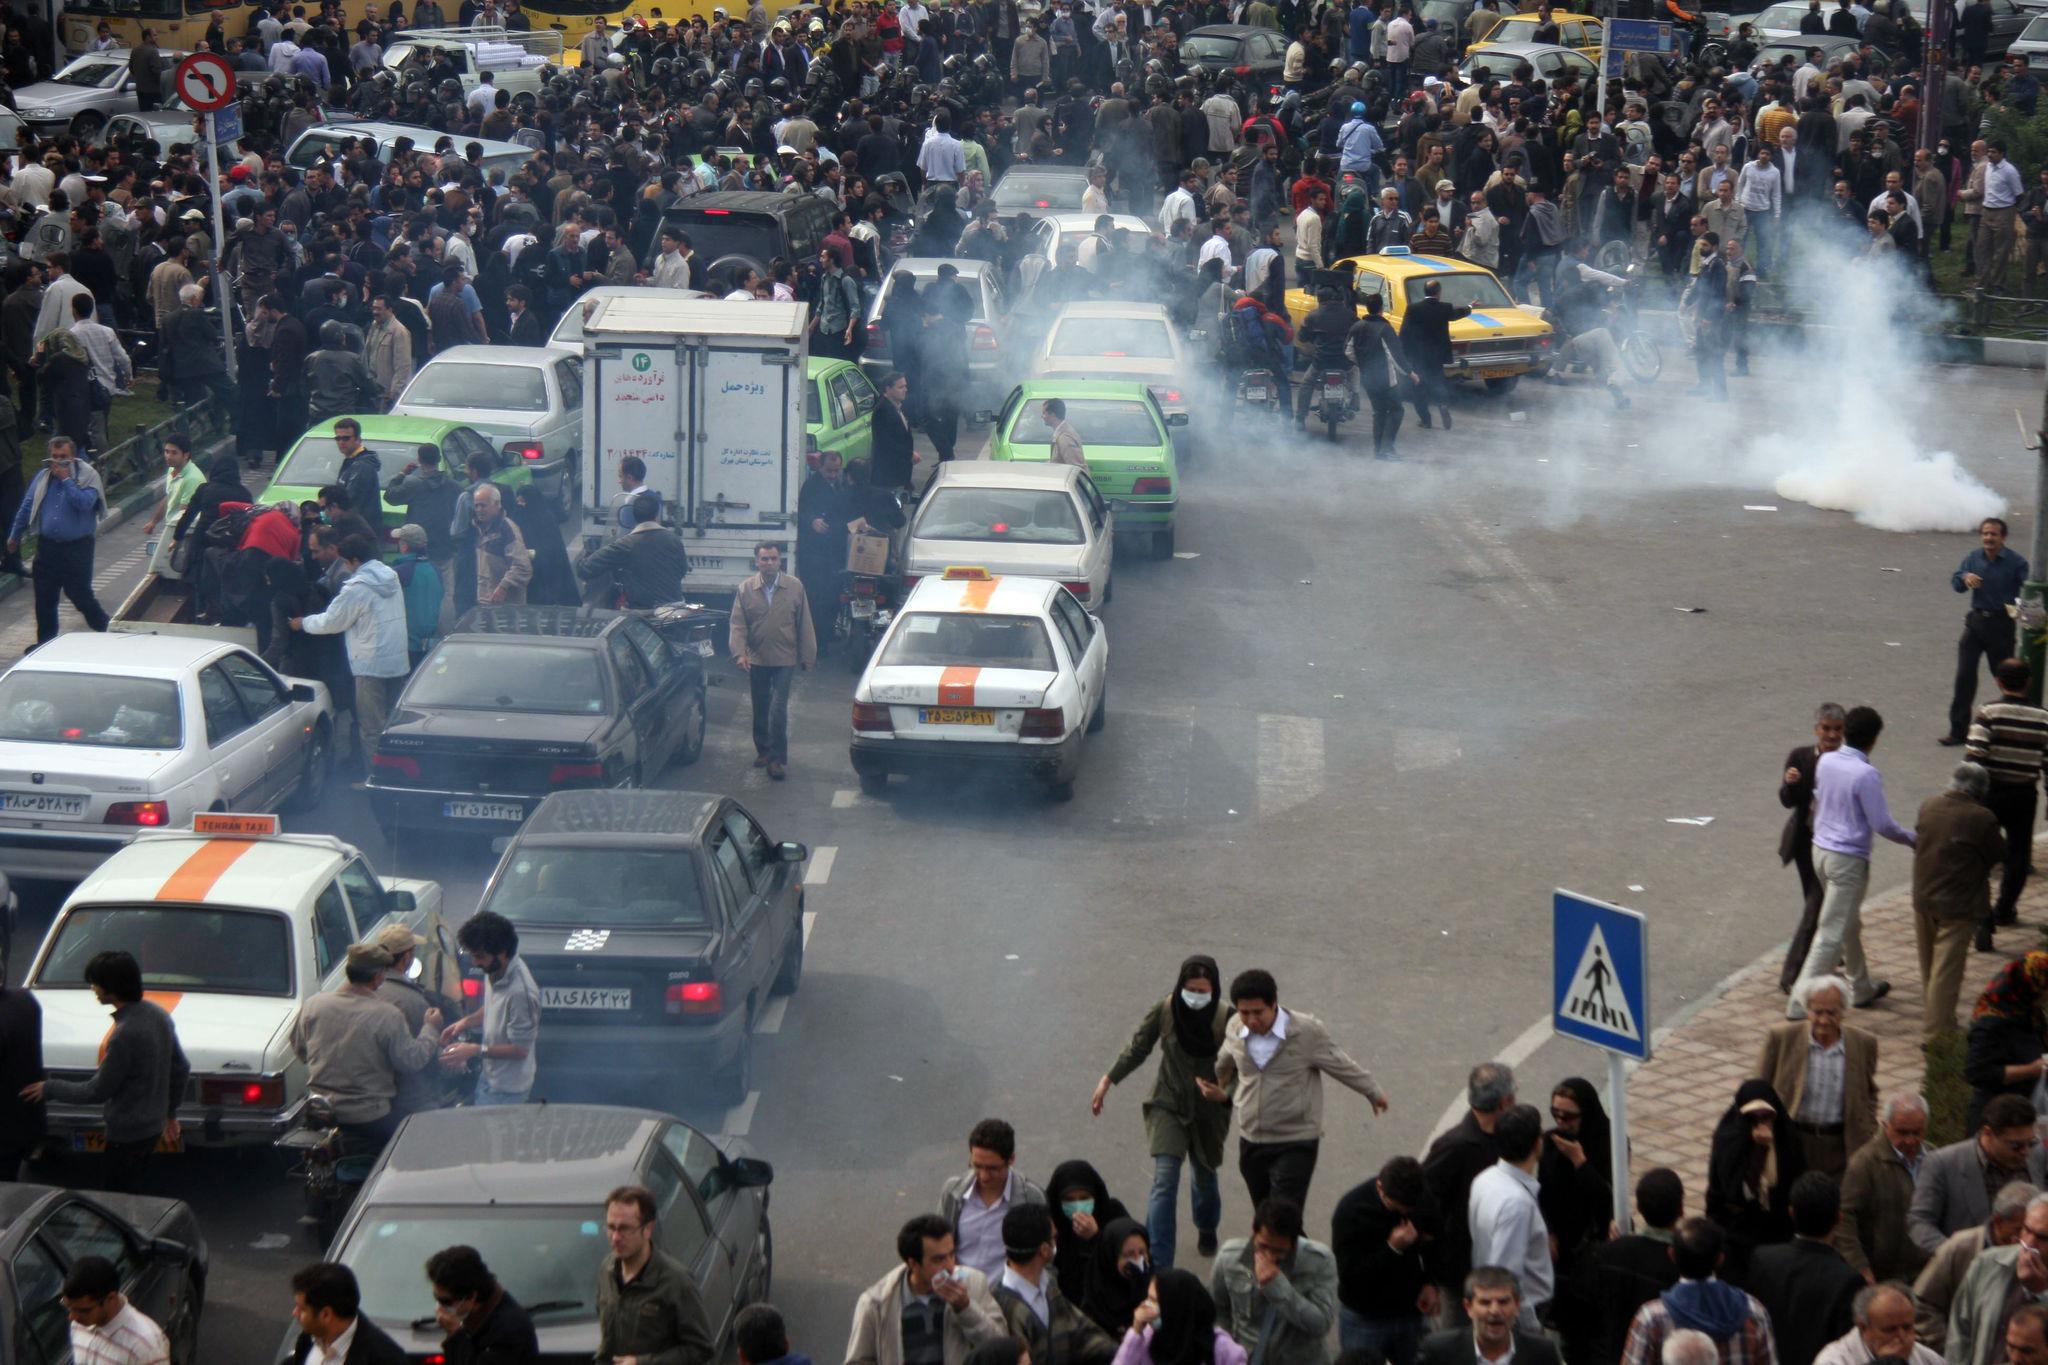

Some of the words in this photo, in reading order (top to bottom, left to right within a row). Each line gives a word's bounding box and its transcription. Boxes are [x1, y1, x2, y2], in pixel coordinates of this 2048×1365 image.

[721, 381, 743, 394] حمل
[744, 381, 765, 395] ویژه
[202, 820, 242, 831] TEHRAN
[244, 821, 269, 832] TAXI
